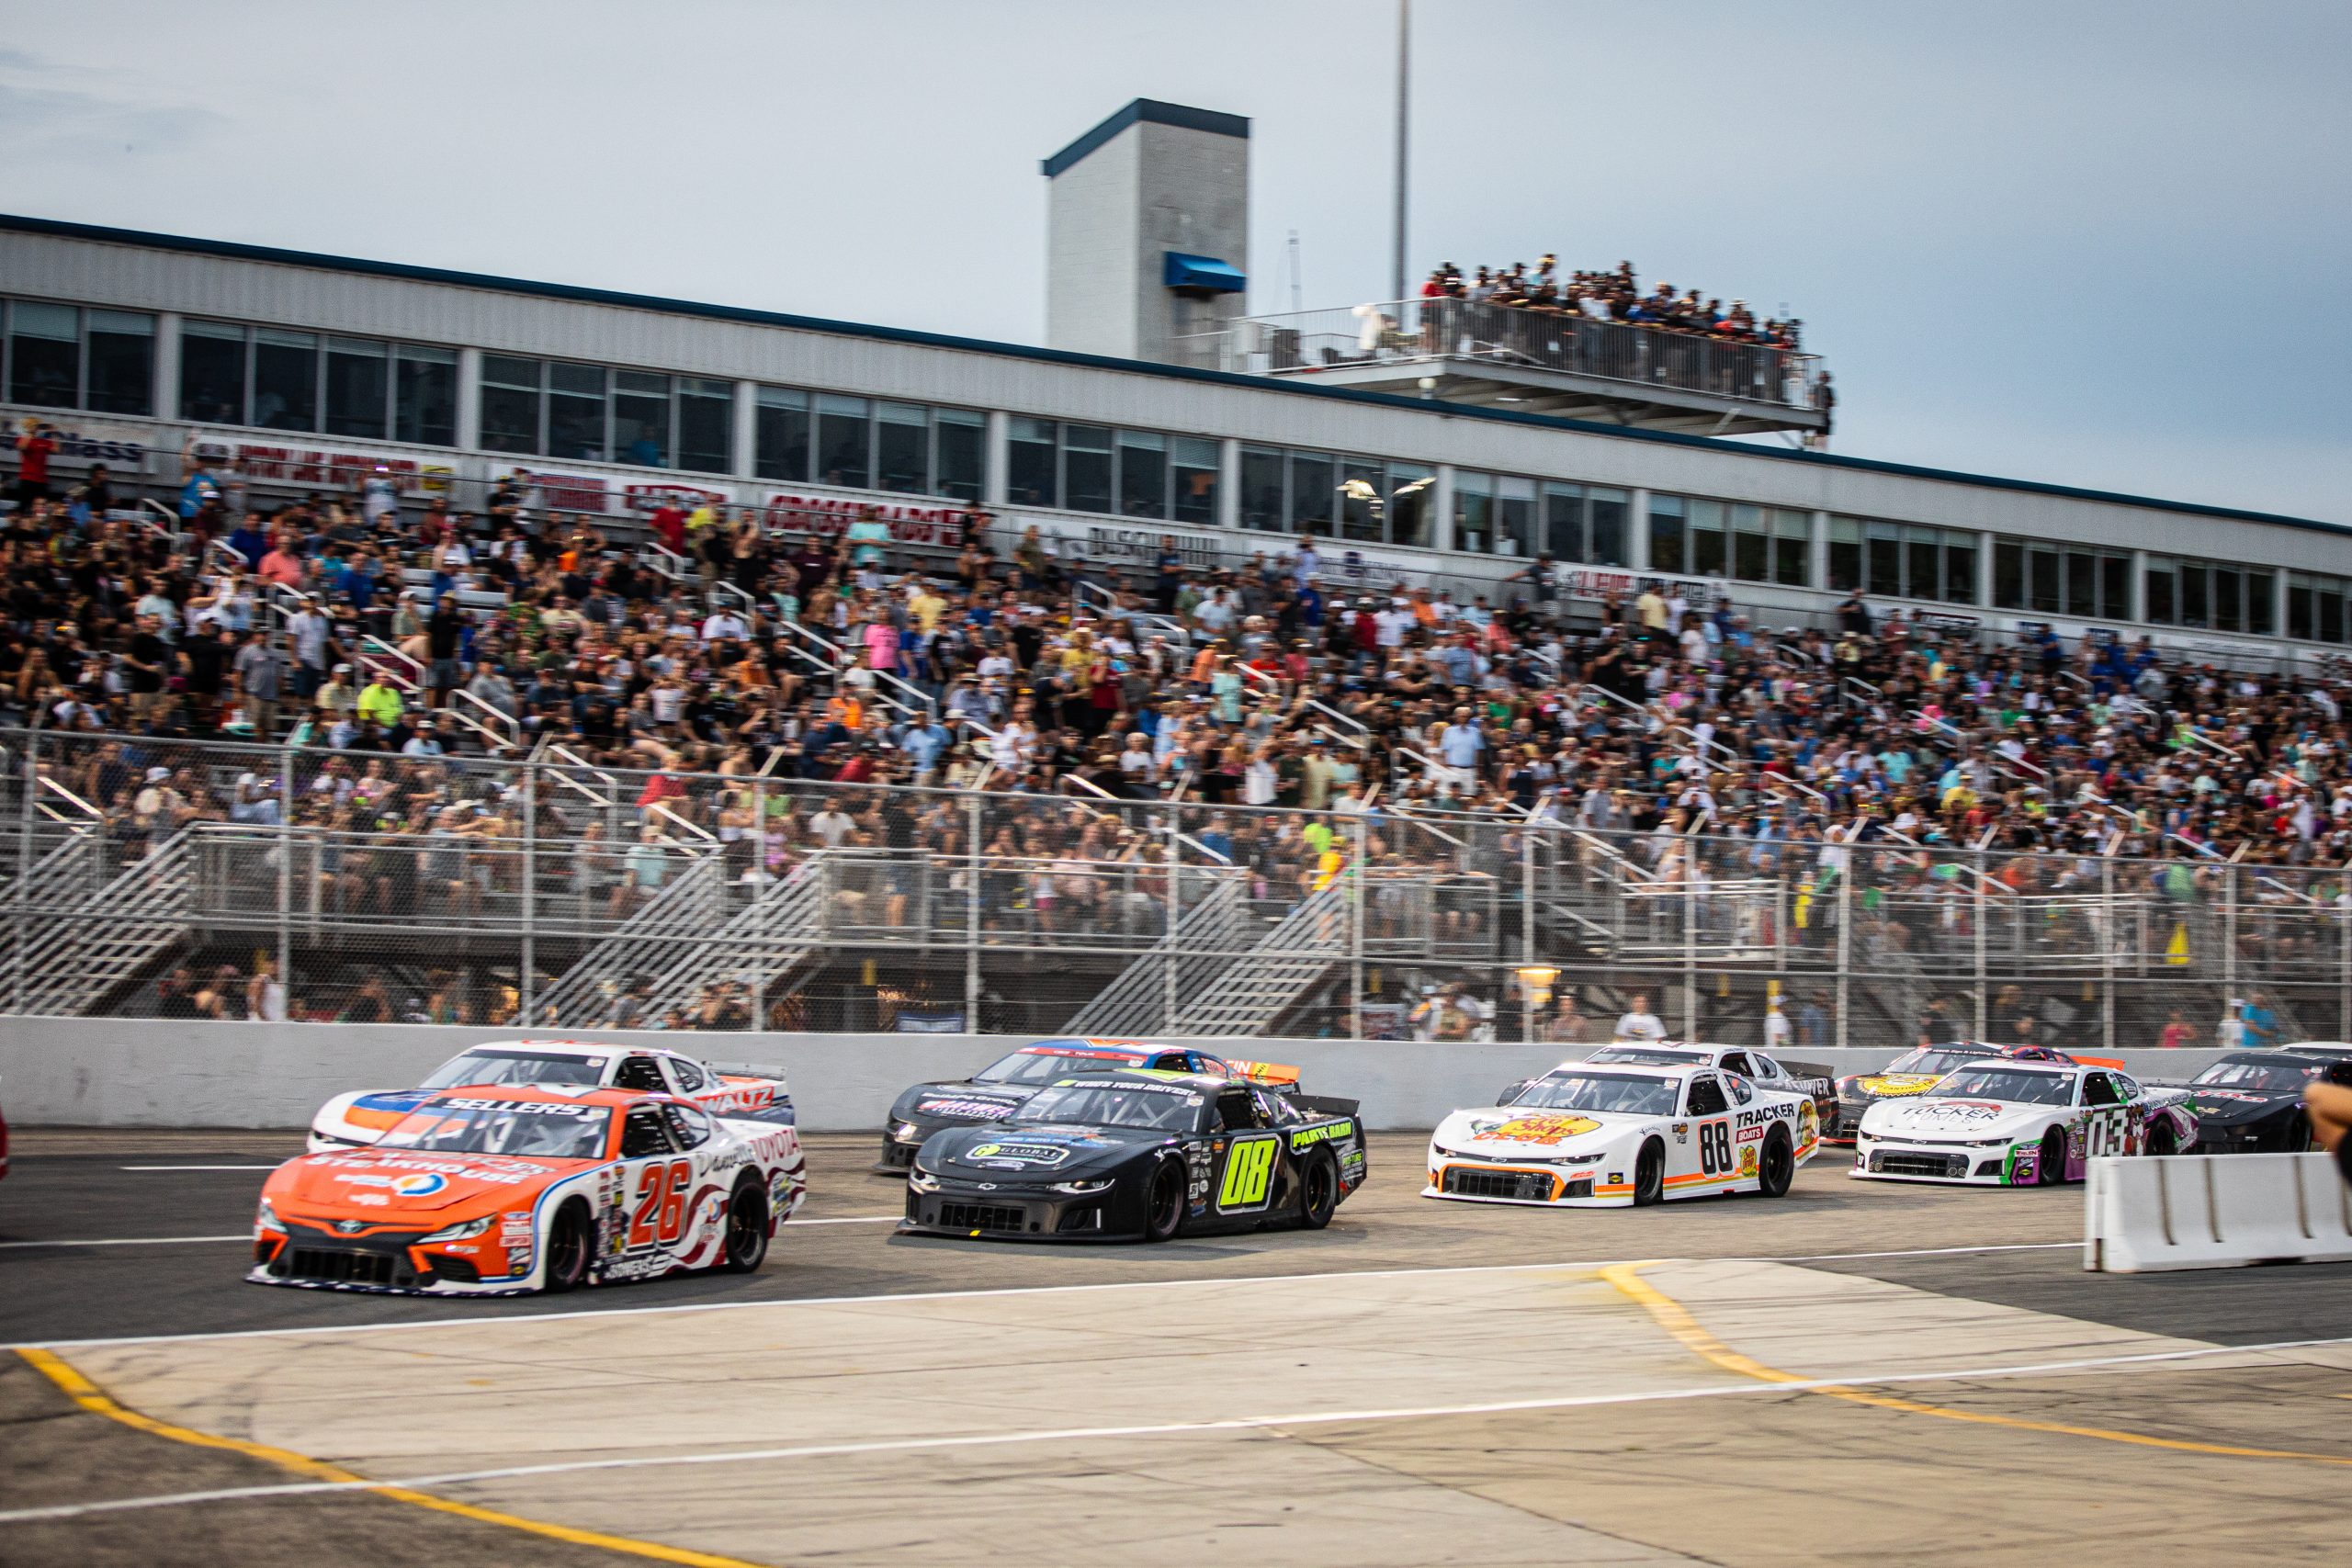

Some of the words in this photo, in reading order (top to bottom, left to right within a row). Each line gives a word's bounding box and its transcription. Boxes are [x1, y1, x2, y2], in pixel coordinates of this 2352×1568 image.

[1113, 1082, 1144, 1090] YOUR
[1142, 1084, 1198, 1097] DRIVER?
[444, 1097, 591, 1116] SELLERS
[702, 1088, 774, 1114] WALTZ
[1736, 1102, 1795, 1128] TRACKER
[1903, 1106, 2000, 1121] TUCKER
[1292, 1126, 1329, 1148] PARTS
[1328, 1122, 1351, 1139] BARN
[1472, 1131, 1563, 1145] CLUB
[1513, 1122, 1577, 1136] Shops
[1737, 1127, 1761, 1141] BOATS
[750, 1127, 802, 1164] TOYOTA
[1000, 1146, 1058, 1159] GLOBAL
[1699, 1121, 1734, 1175] 88
[1218, 1138, 1277, 1207] 08
[627, 1158, 693, 1251] 26
